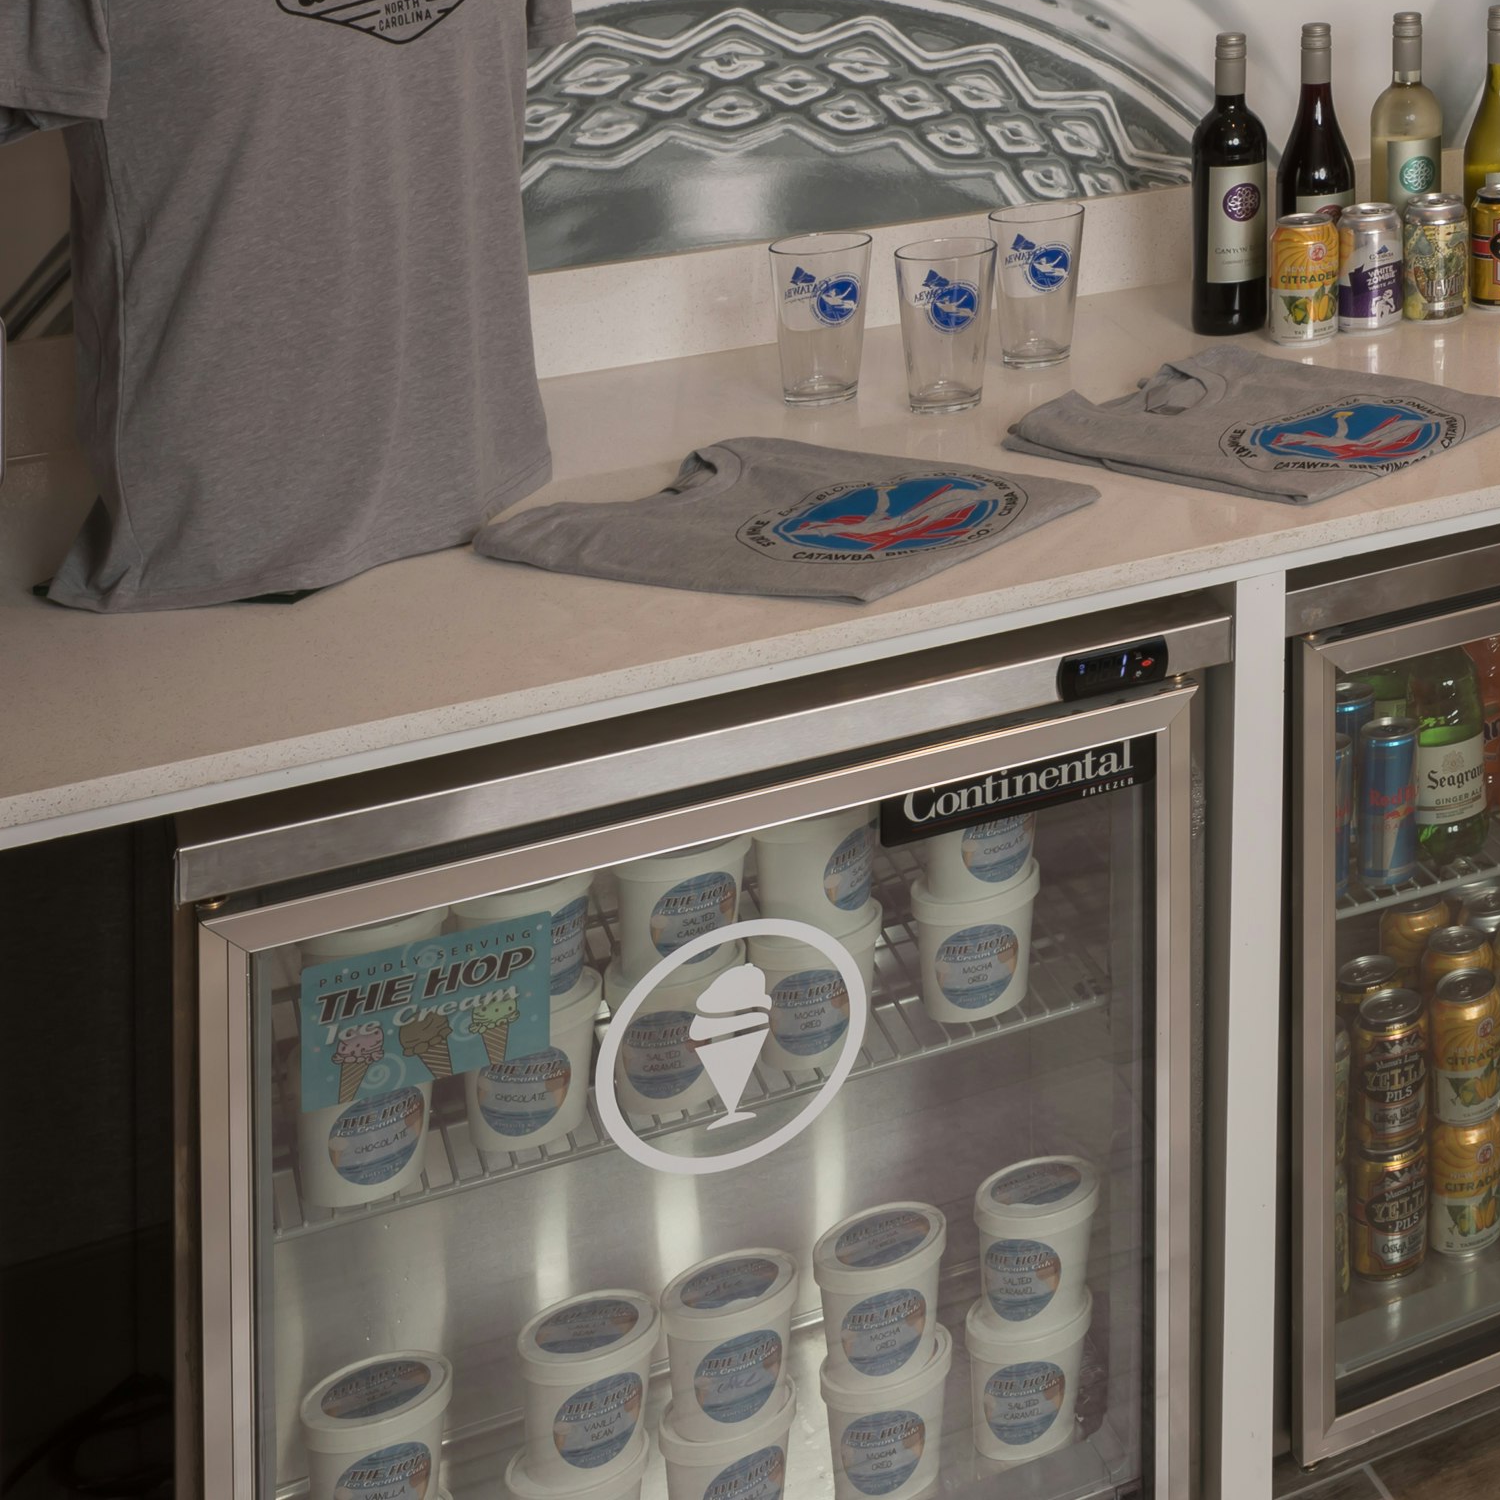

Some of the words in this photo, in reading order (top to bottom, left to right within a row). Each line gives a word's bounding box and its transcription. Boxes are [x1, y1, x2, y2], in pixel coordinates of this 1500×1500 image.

[379, 10, 432, 31] CAROLINA
[1368, 265, 1394, 278] WHITE
[792, 552, 875, 561] CATAWBA
[903, 740, 1133, 822] Continental
[1082, 777, 1134, 796] FREEZER
[1435, 792, 1468, 806] GINGER
[320, 956, 420, 988] PROUDLY
[437, 930, 531, 959] SERVING
[318, 974, 415, 1024] THE
[423, 947, 534, 999] HOP
[325, 1020, 380, 1044] Ice
[392, 986, 520, 1026] Cream
[1386, 1087, 1412, 1102] PILS
[1395, 1215, 1419, 1232] PILS
